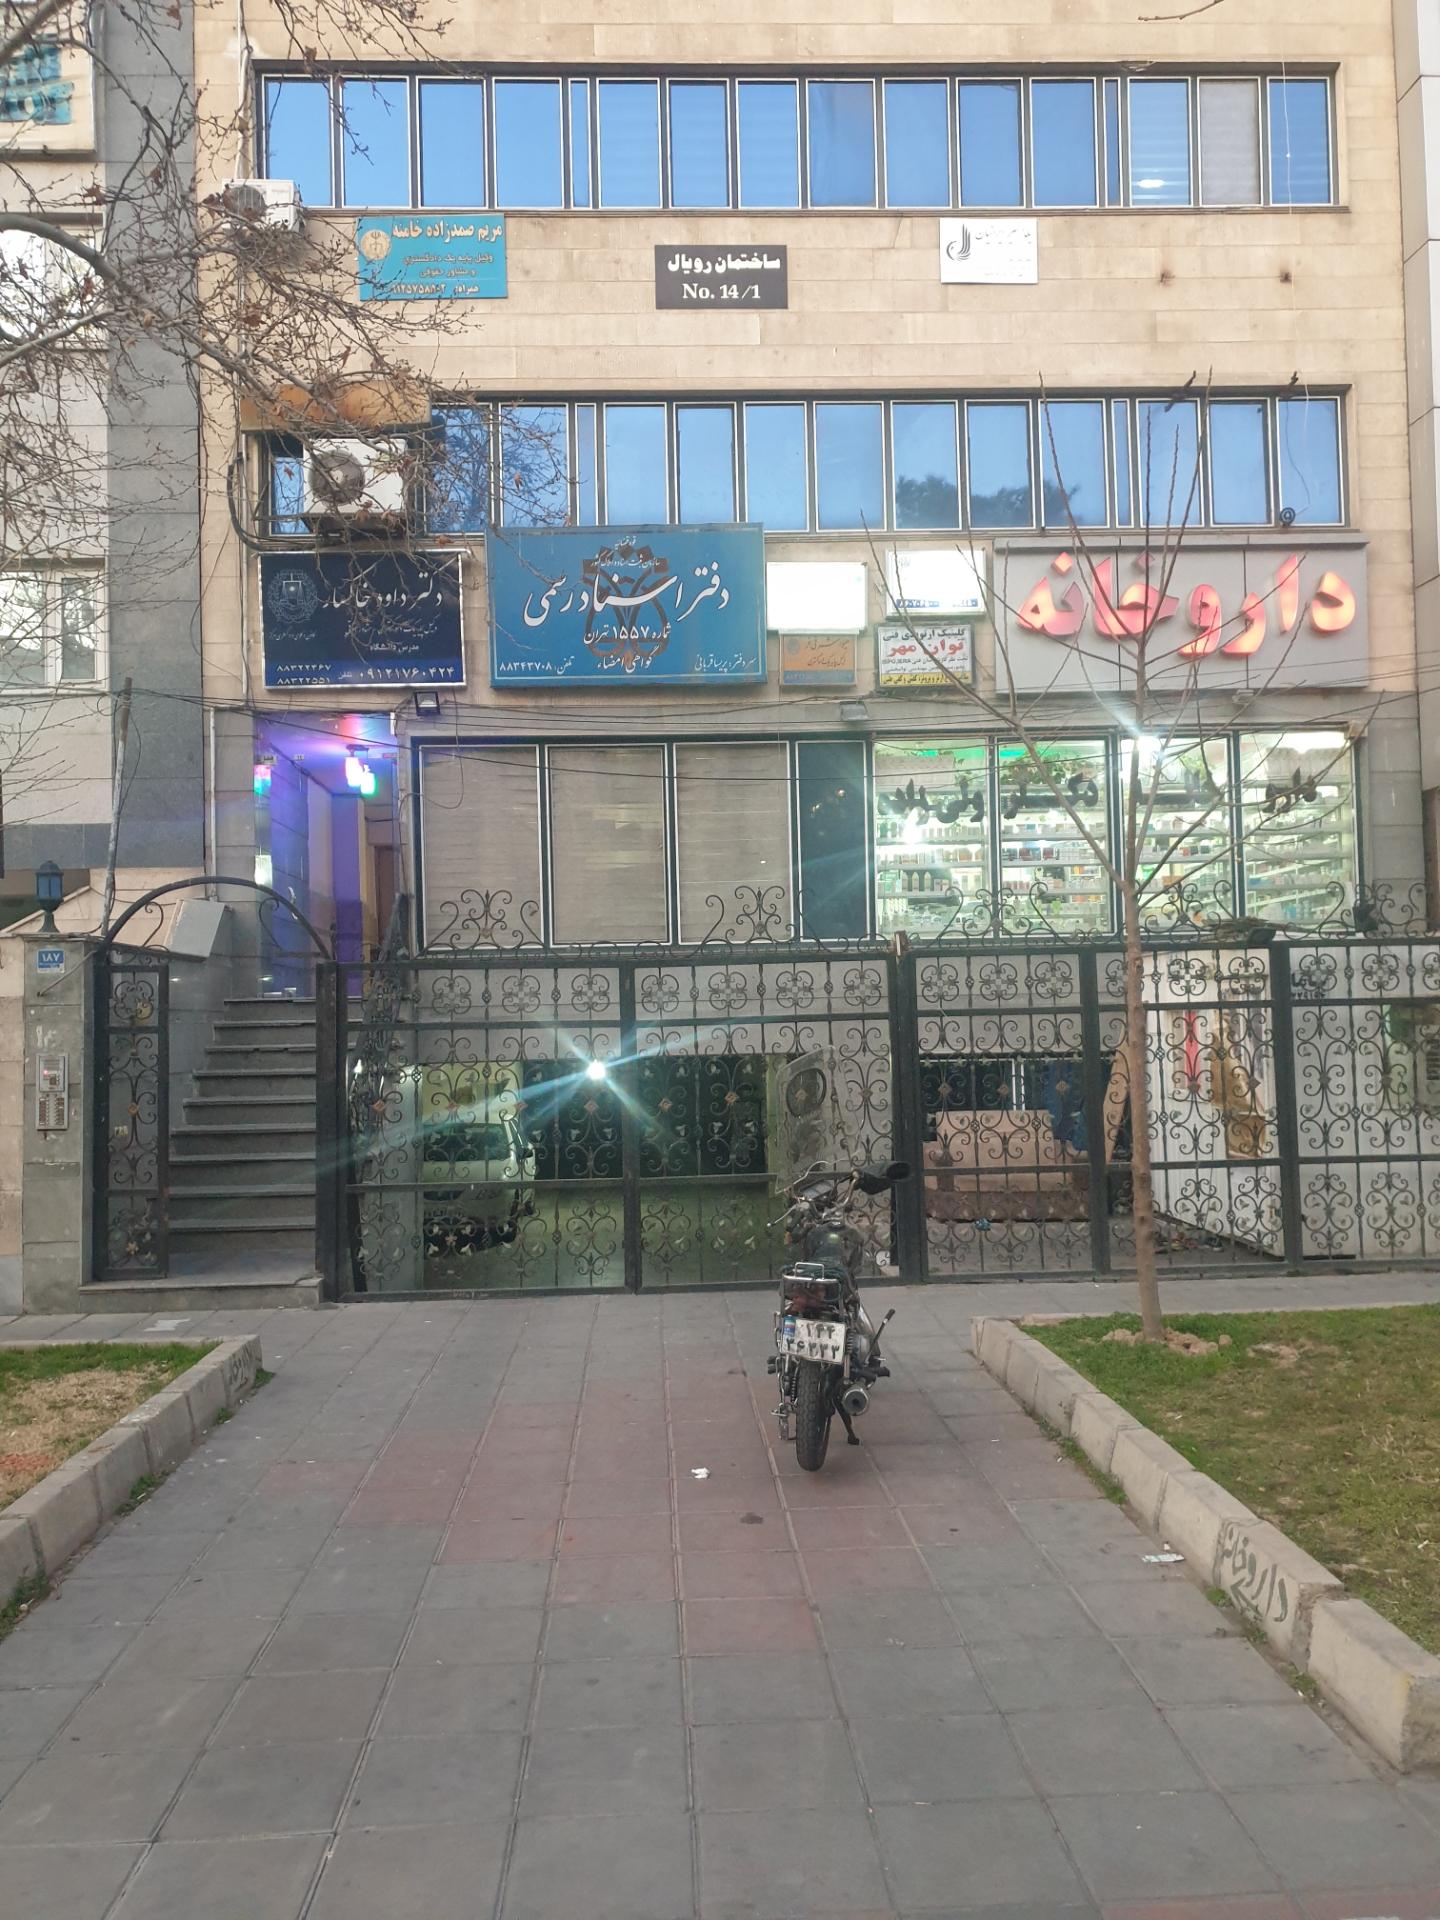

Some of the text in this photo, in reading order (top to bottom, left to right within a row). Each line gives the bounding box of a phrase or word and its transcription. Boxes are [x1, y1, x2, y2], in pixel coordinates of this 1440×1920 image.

[392, 219, 423, 239] خامنه
[477, 223, 503, 242] مریم
[667, 252, 781, 275] ساختمان رویال
[681, 282, 716, 300] No.
[408, 571, 442, 612] دکتر
[523, 565, 730, 627] دفتر اسناد رسمی
[1016, 550, 1357, 656] داروخانه
[584, 622, 672, 645] شماره ۱۵۵۷ تهران
[882, 631, 899, 642] فنی
[937, 627, 967, 640] کلینیک
[597, 644, 660, 673] گواهی امضاء
[886, 638, 965, 658] توان مهر
